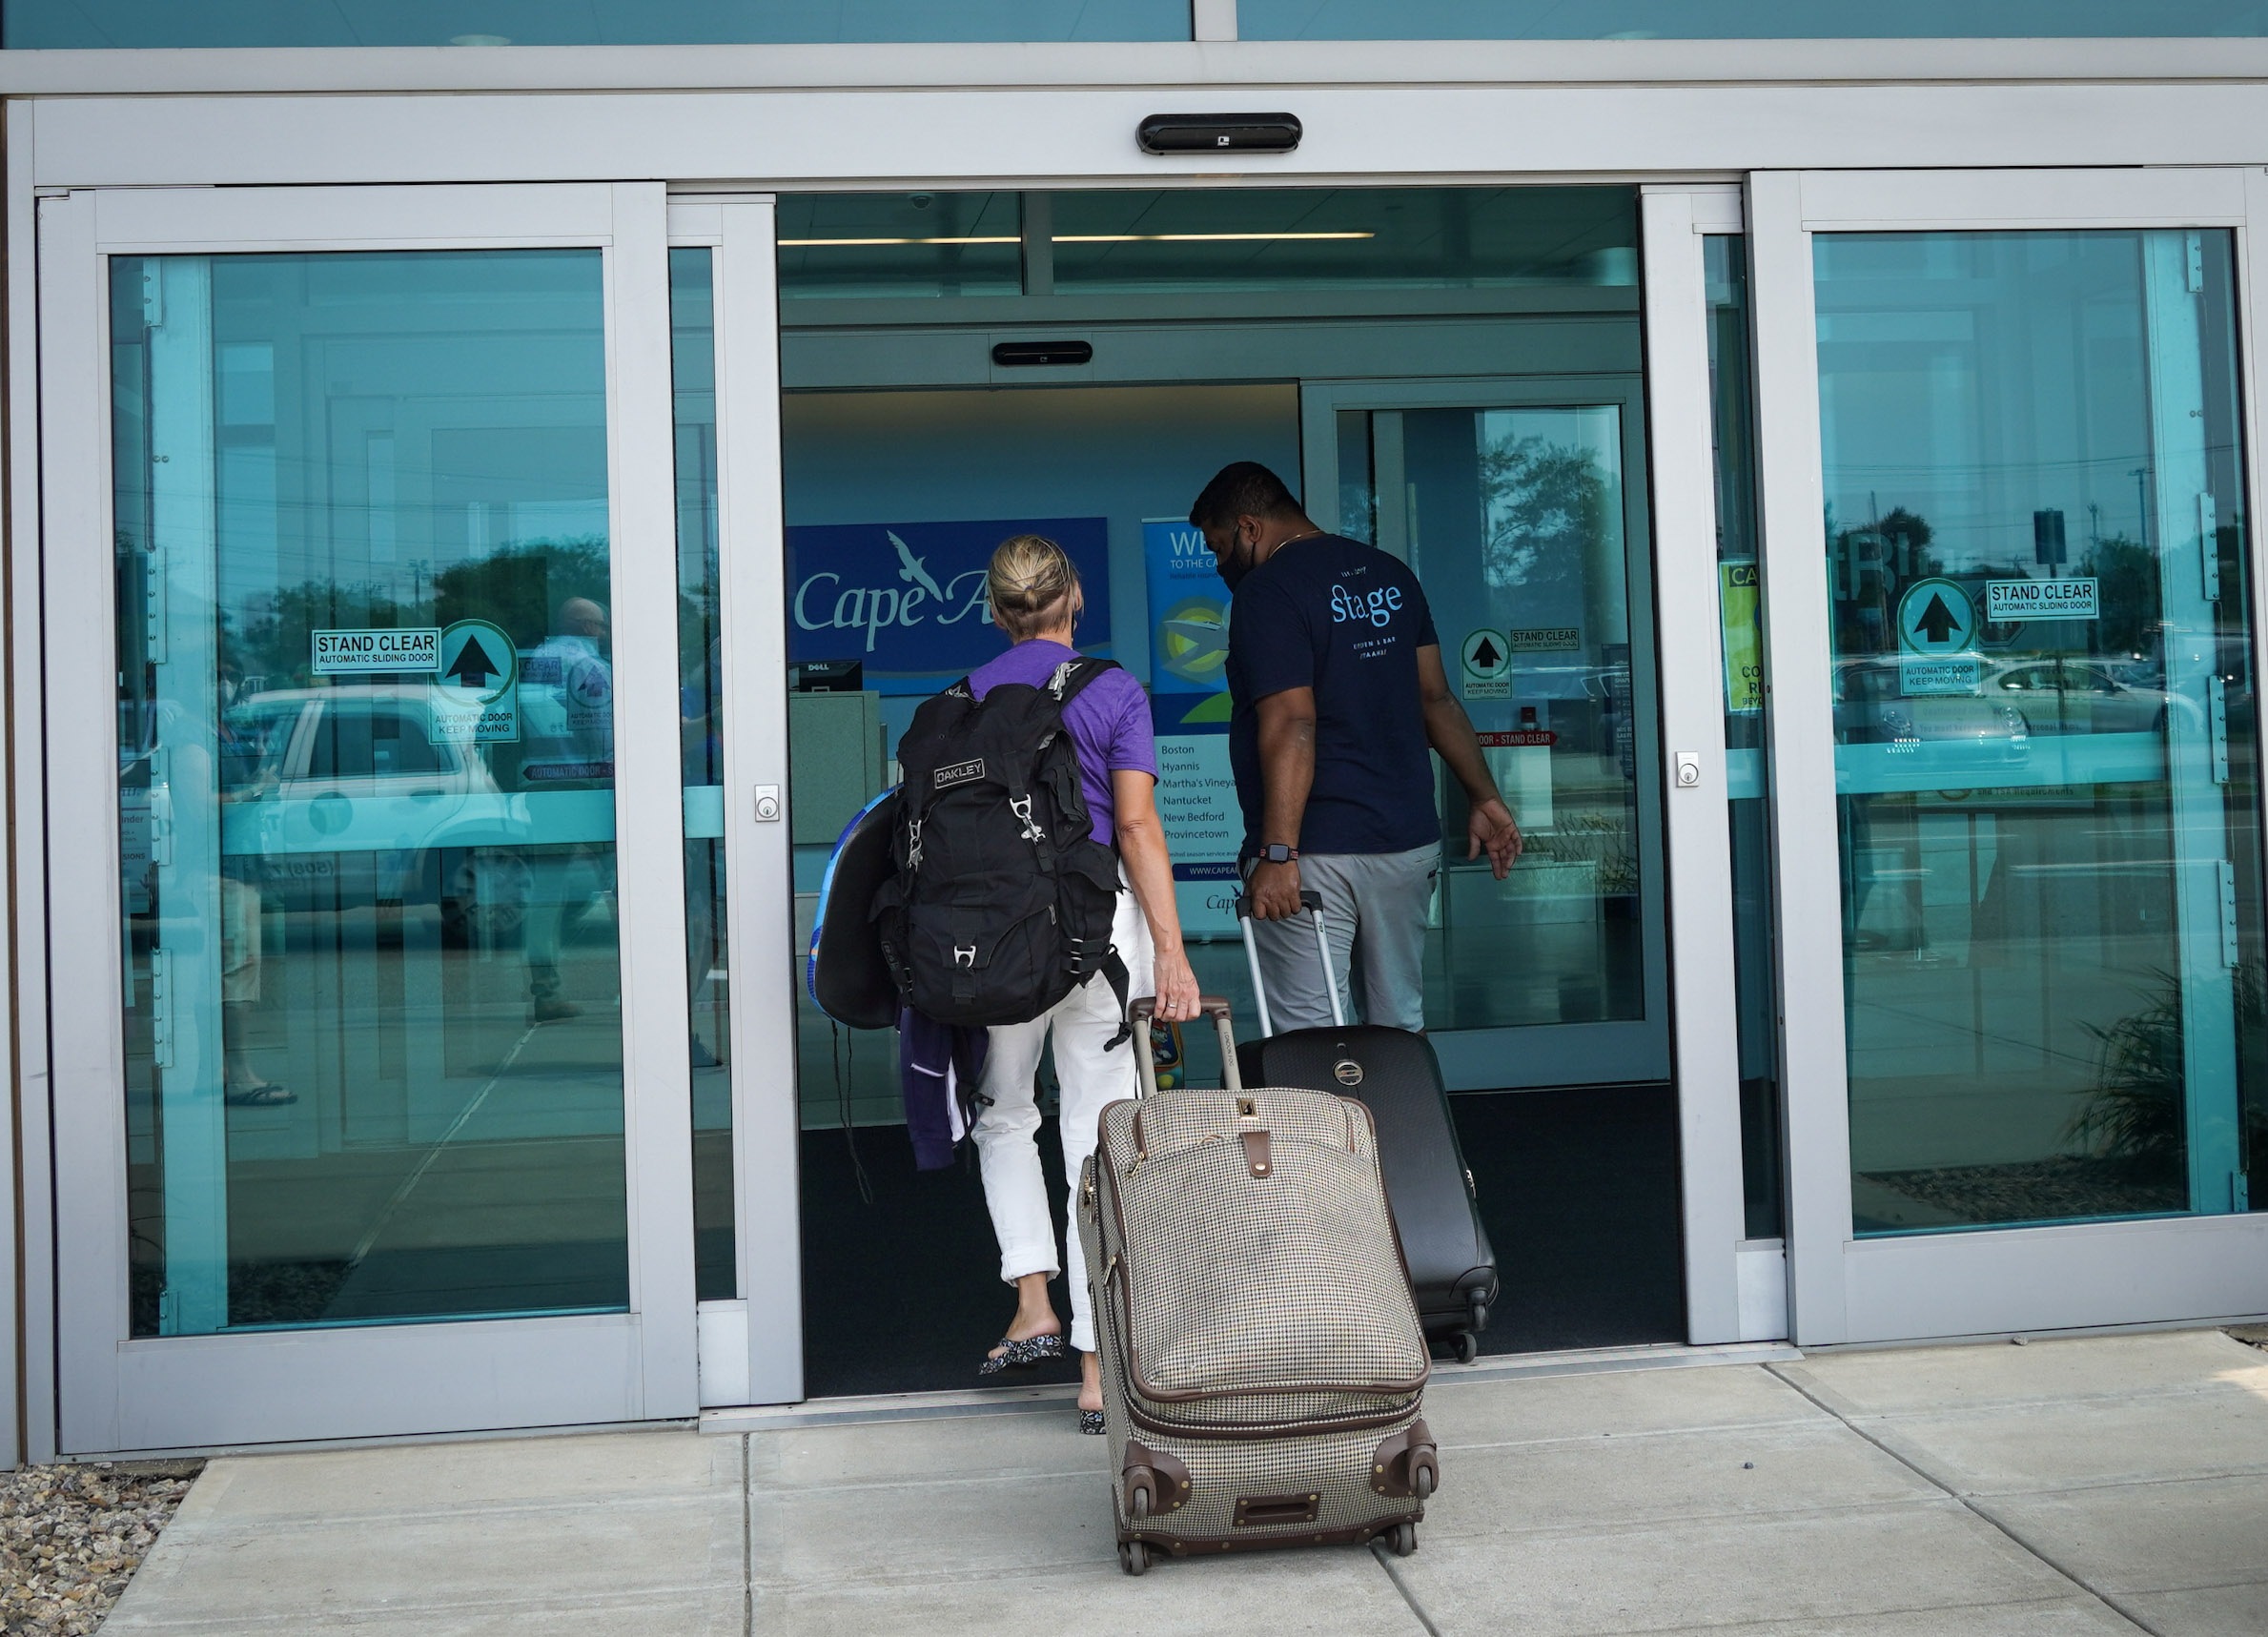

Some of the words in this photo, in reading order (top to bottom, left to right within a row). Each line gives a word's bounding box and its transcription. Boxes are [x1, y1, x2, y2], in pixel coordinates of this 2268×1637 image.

[1170, 559, 1183, 569] TO
[1185, 559, 1204, 568] THE
[1992, 585, 2040, 601] STAND
[2044, 583, 2093, 600] CLEAR
[1331, 584, 1402, 627] Stage
[1992, 602, 2037, 612] AUTOMATIC
[2038, 601, 2069, 610] SLIDING
[2069, 600, 2093, 609] DOOR
[794, 572, 925, 652] Cape
[1512, 632, 1544, 642] STAND
[1545, 630, 1578, 641] CLEAR
[318, 636, 374, 652] STAND
[378, 634, 435, 651] CLEAR
[319, 654, 370, 664] AUTOMATIC
[372, 653, 407, 663] SLIDING
[408, 652, 435, 662] DOOR
[1907, 665, 1951, 676] AUTOMATIC
[1952, 665, 1974, 674] DOOR
[1910, 677, 1934, 686] KEEP
[1935, 675, 1972, 685] MOVING
[1749, 682, 1762, 694] R
[436, 714, 486, 724] AUTOMATIC
[487, 713, 513, 722] DOOR
[439, 726, 466, 734] KEEP
[468, 724, 510, 733] MOVING
[1501, 734, 1525, 745] STAND
[1526, 733, 1550, 744] CLEAR
[1161, 746, 1195, 754] Boston
[532, 766, 578, 778] AUTOMATIC
[936, 763, 982, 783] OAKLEY
[1162, 762, 1200, 773] Hyannis
[1163, 778, 1203, 788] Martha's
[1163, 795, 1212, 805] Nantucket
[1164, 813, 1185, 822] New
[1187, 811, 1225, 821] Bedford
[1165, 829, 1229, 839] Provincetown
[1206, 895, 1237, 914] Cap
